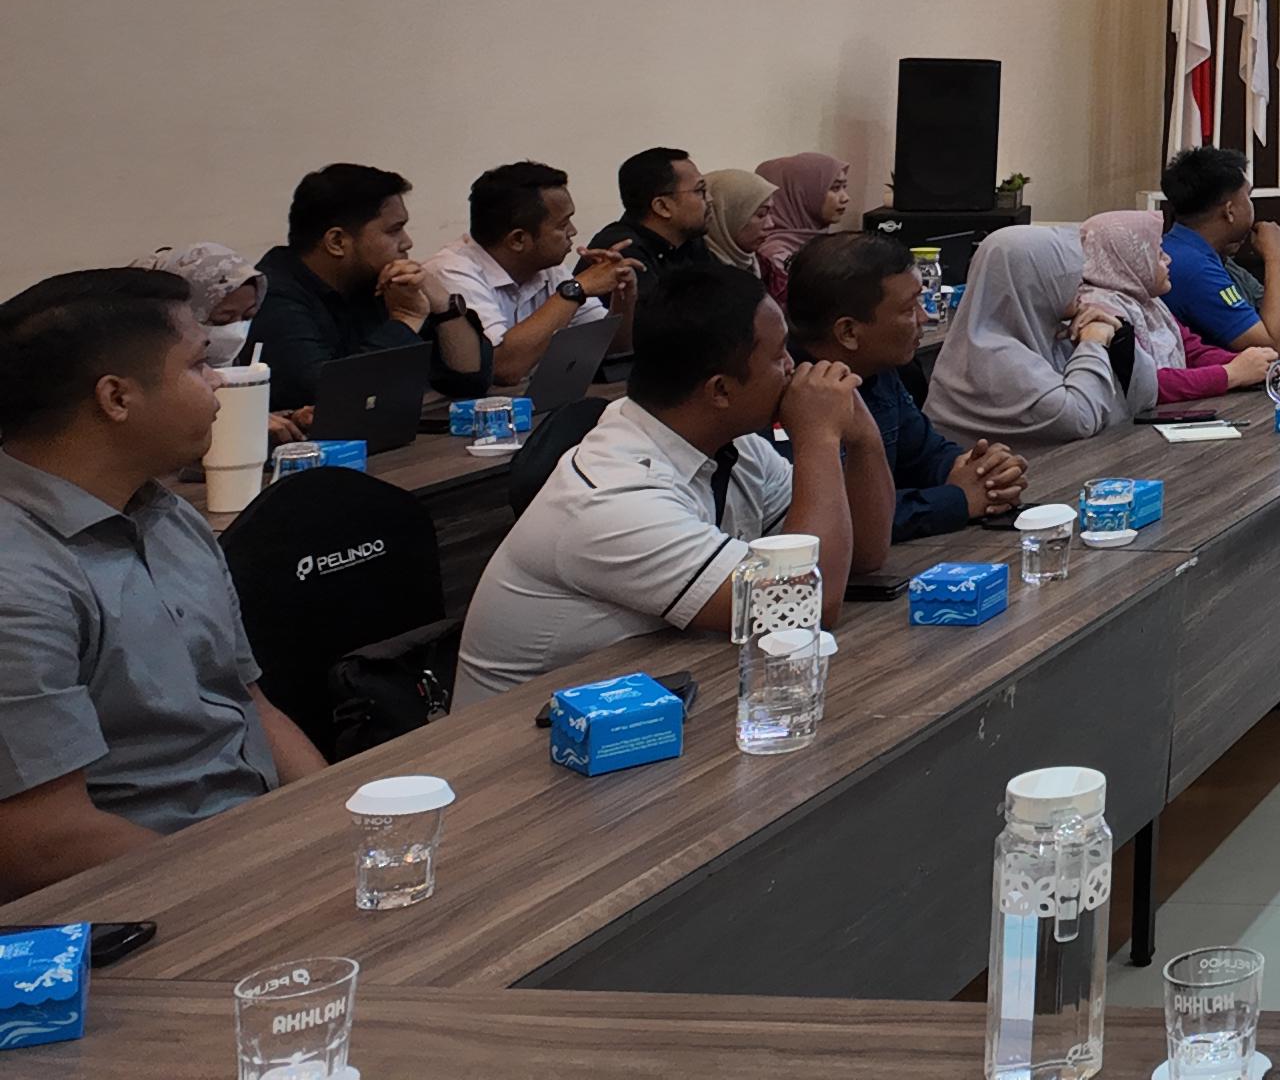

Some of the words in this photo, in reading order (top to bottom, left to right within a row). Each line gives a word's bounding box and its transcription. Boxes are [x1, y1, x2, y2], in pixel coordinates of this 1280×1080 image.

[317, 539, 385, 571] PELINDO
[272, 996, 346, 1035] AKHLAK
[1174, 992, 1235, 1018] AKHLAK
